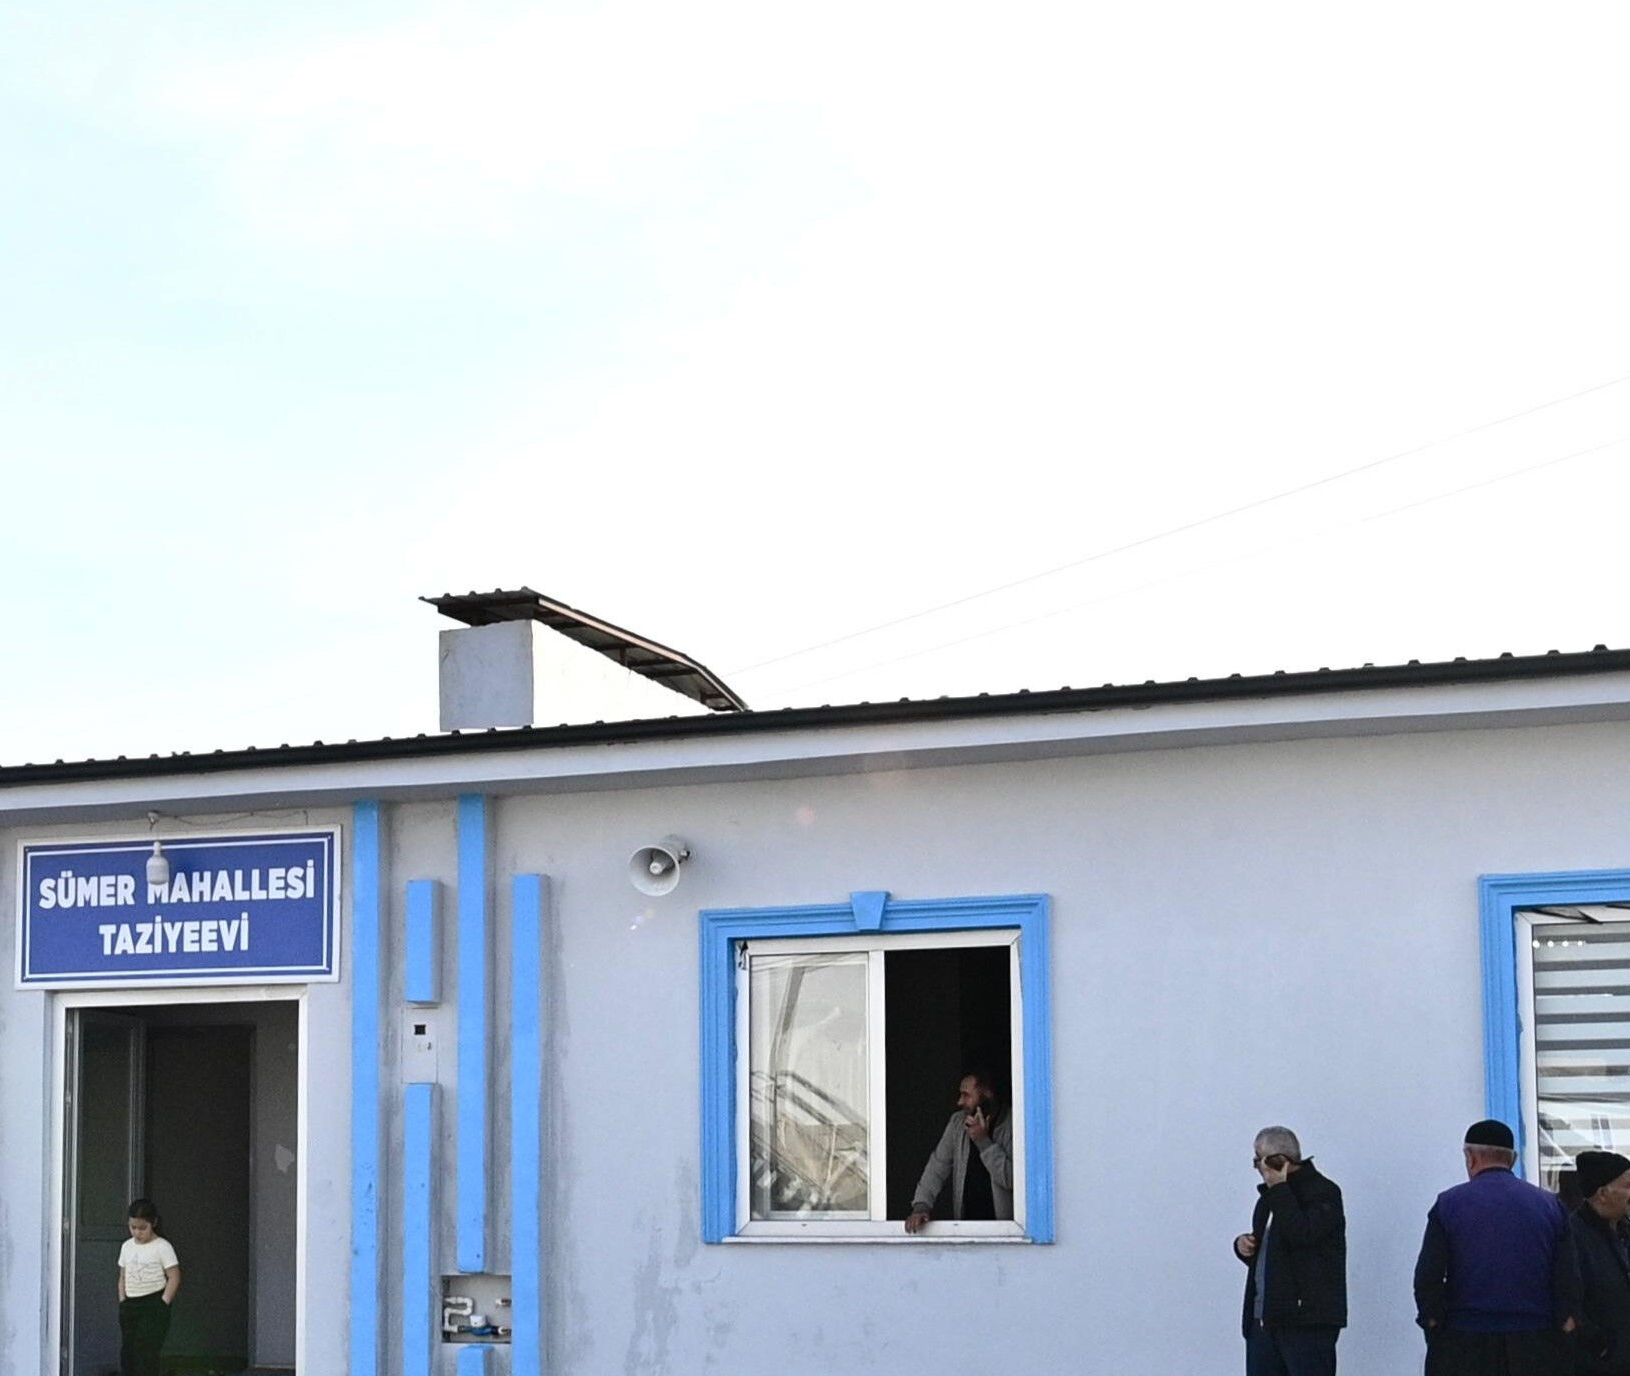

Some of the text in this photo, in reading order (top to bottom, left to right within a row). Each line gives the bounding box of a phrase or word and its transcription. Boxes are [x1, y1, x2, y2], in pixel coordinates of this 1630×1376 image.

[38, 859, 316, 909] SÜMER MAHALLESİ
[99, 911, 250, 956] TAZİYEEVİ
